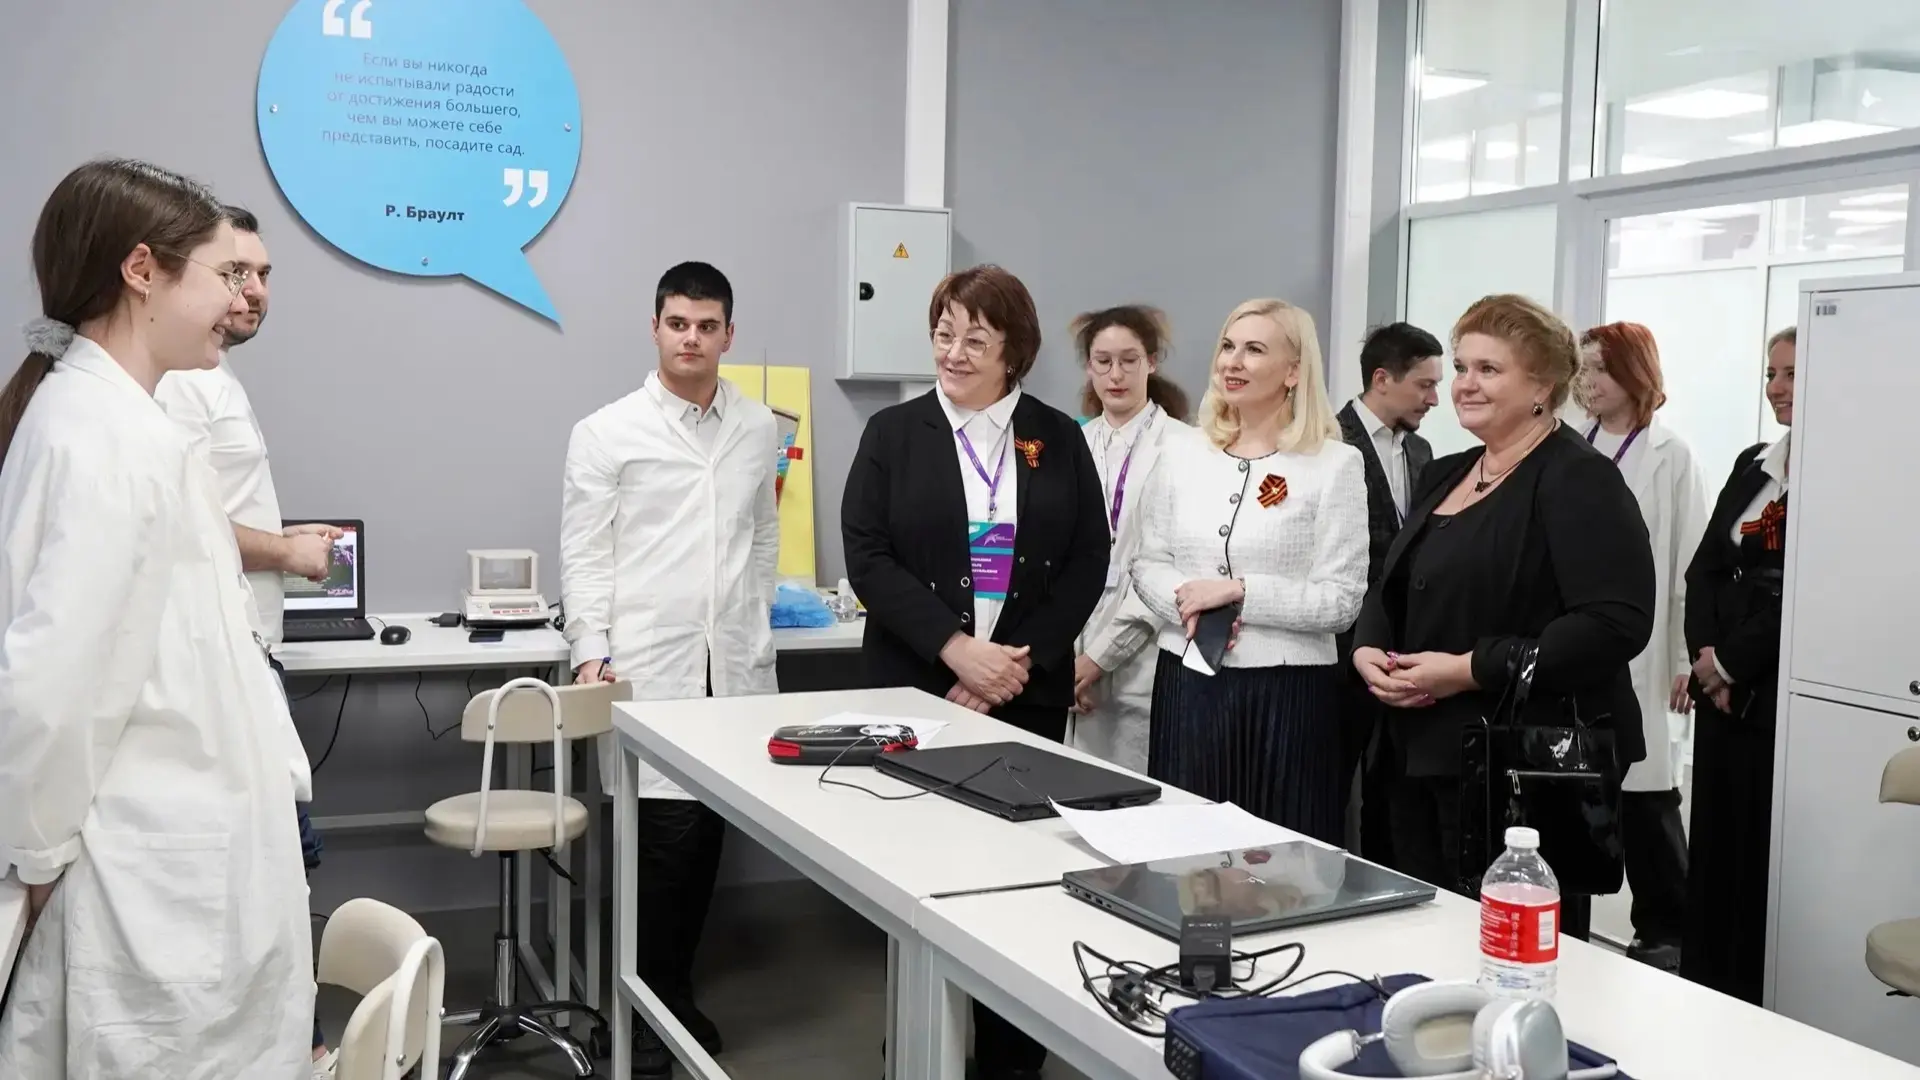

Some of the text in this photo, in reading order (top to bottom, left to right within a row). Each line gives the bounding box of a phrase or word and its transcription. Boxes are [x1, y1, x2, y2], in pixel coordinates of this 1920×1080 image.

[363, 52, 487, 77] Если вы никогда
[335, 72, 514, 97] не испытывали радости
[327, 91, 520, 118] от достижения большего,
[348, 113, 502, 134] чем вы можете себе
[322, 130, 525, 157] представить, посадите сад.
[385, 204, 465, 223] Р. Браулт
